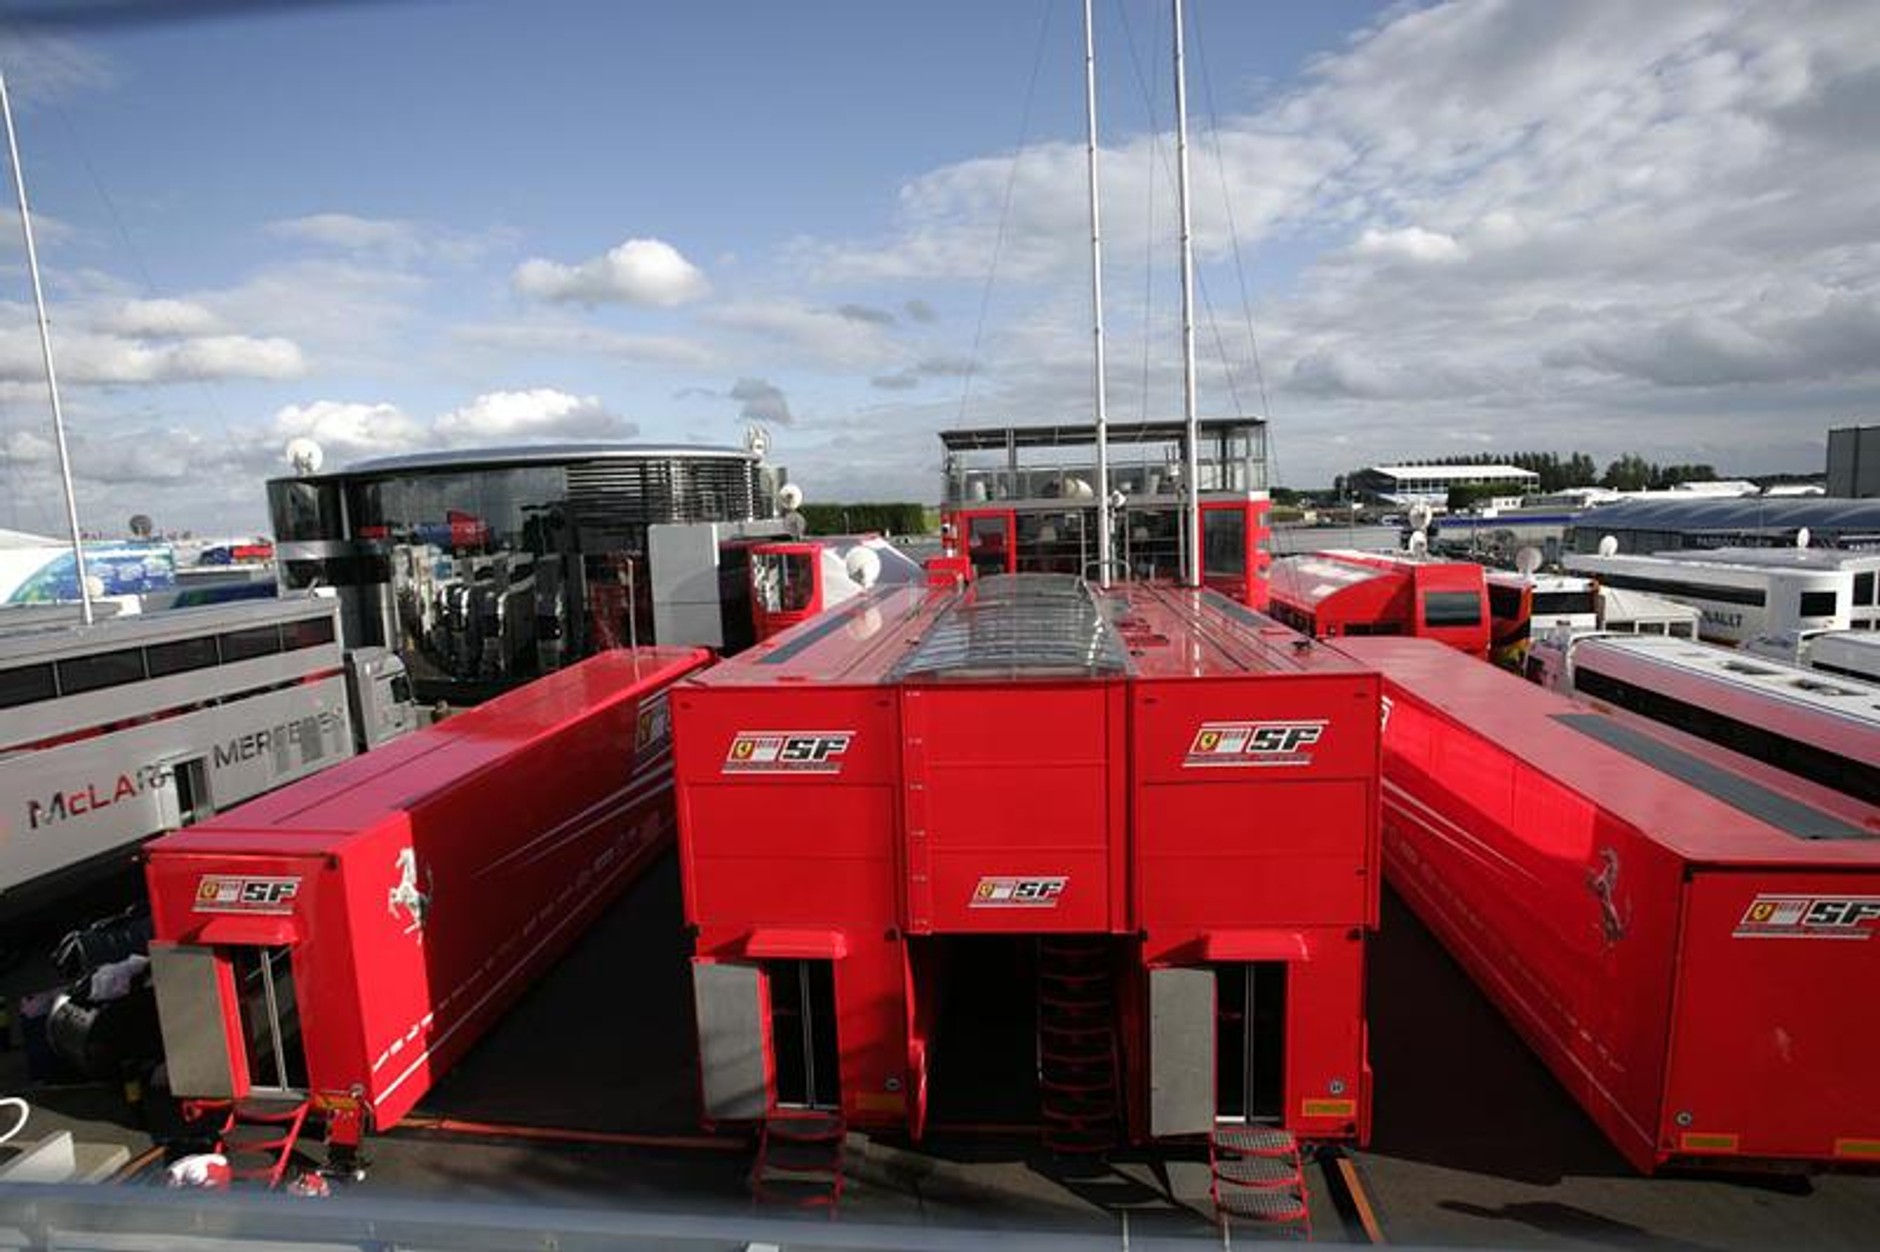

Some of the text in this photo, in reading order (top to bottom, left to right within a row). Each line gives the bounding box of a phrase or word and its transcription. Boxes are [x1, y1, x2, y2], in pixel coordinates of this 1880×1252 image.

[781, 738, 847, 760] SF
[1249, 728, 1321, 751] SF
[243, 882, 296, 902] SF
[1014, 881, 1062, 898] SF
[1804, 900, 1880, 925] SF
